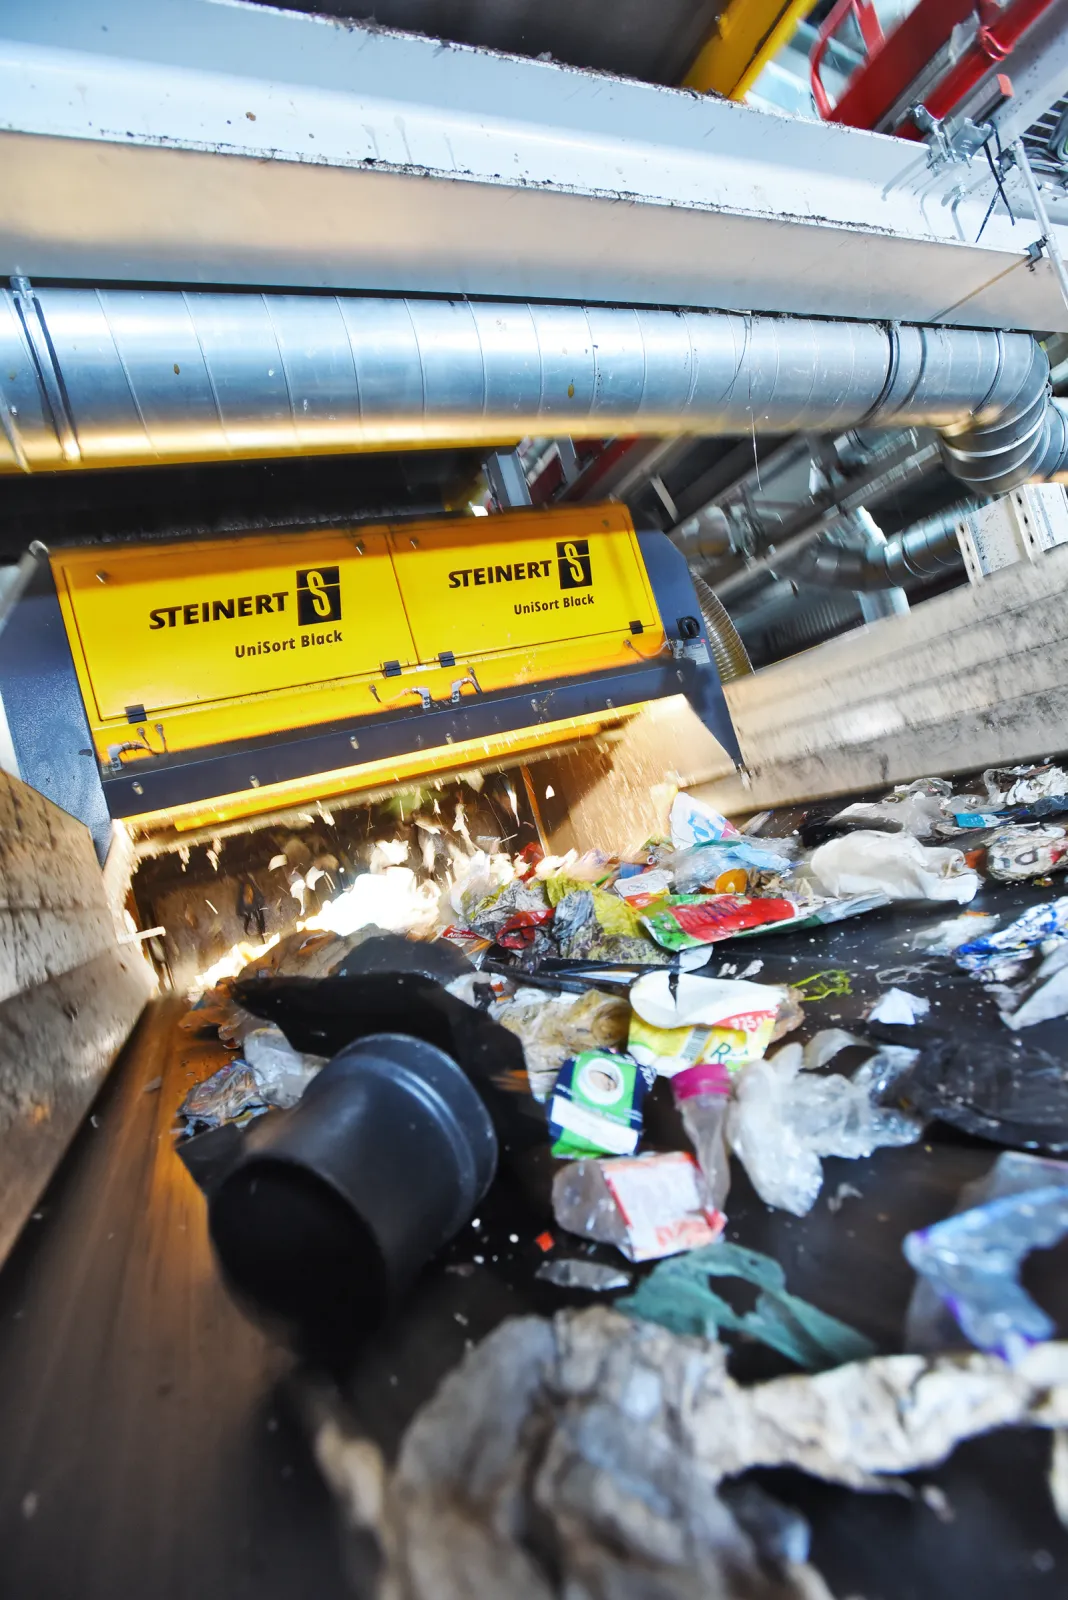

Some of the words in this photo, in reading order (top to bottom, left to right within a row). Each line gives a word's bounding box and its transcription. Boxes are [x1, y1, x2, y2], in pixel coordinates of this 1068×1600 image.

[448, 560, 552, 589] STEINERT
[149, 592, 289, 630] STEINERT
[513, 599, 560, 616] UniSort
[563, 593, 595, 609] Black
[235, 637, 296, 659] UniSort
[301, 629, 343, 648] Black
